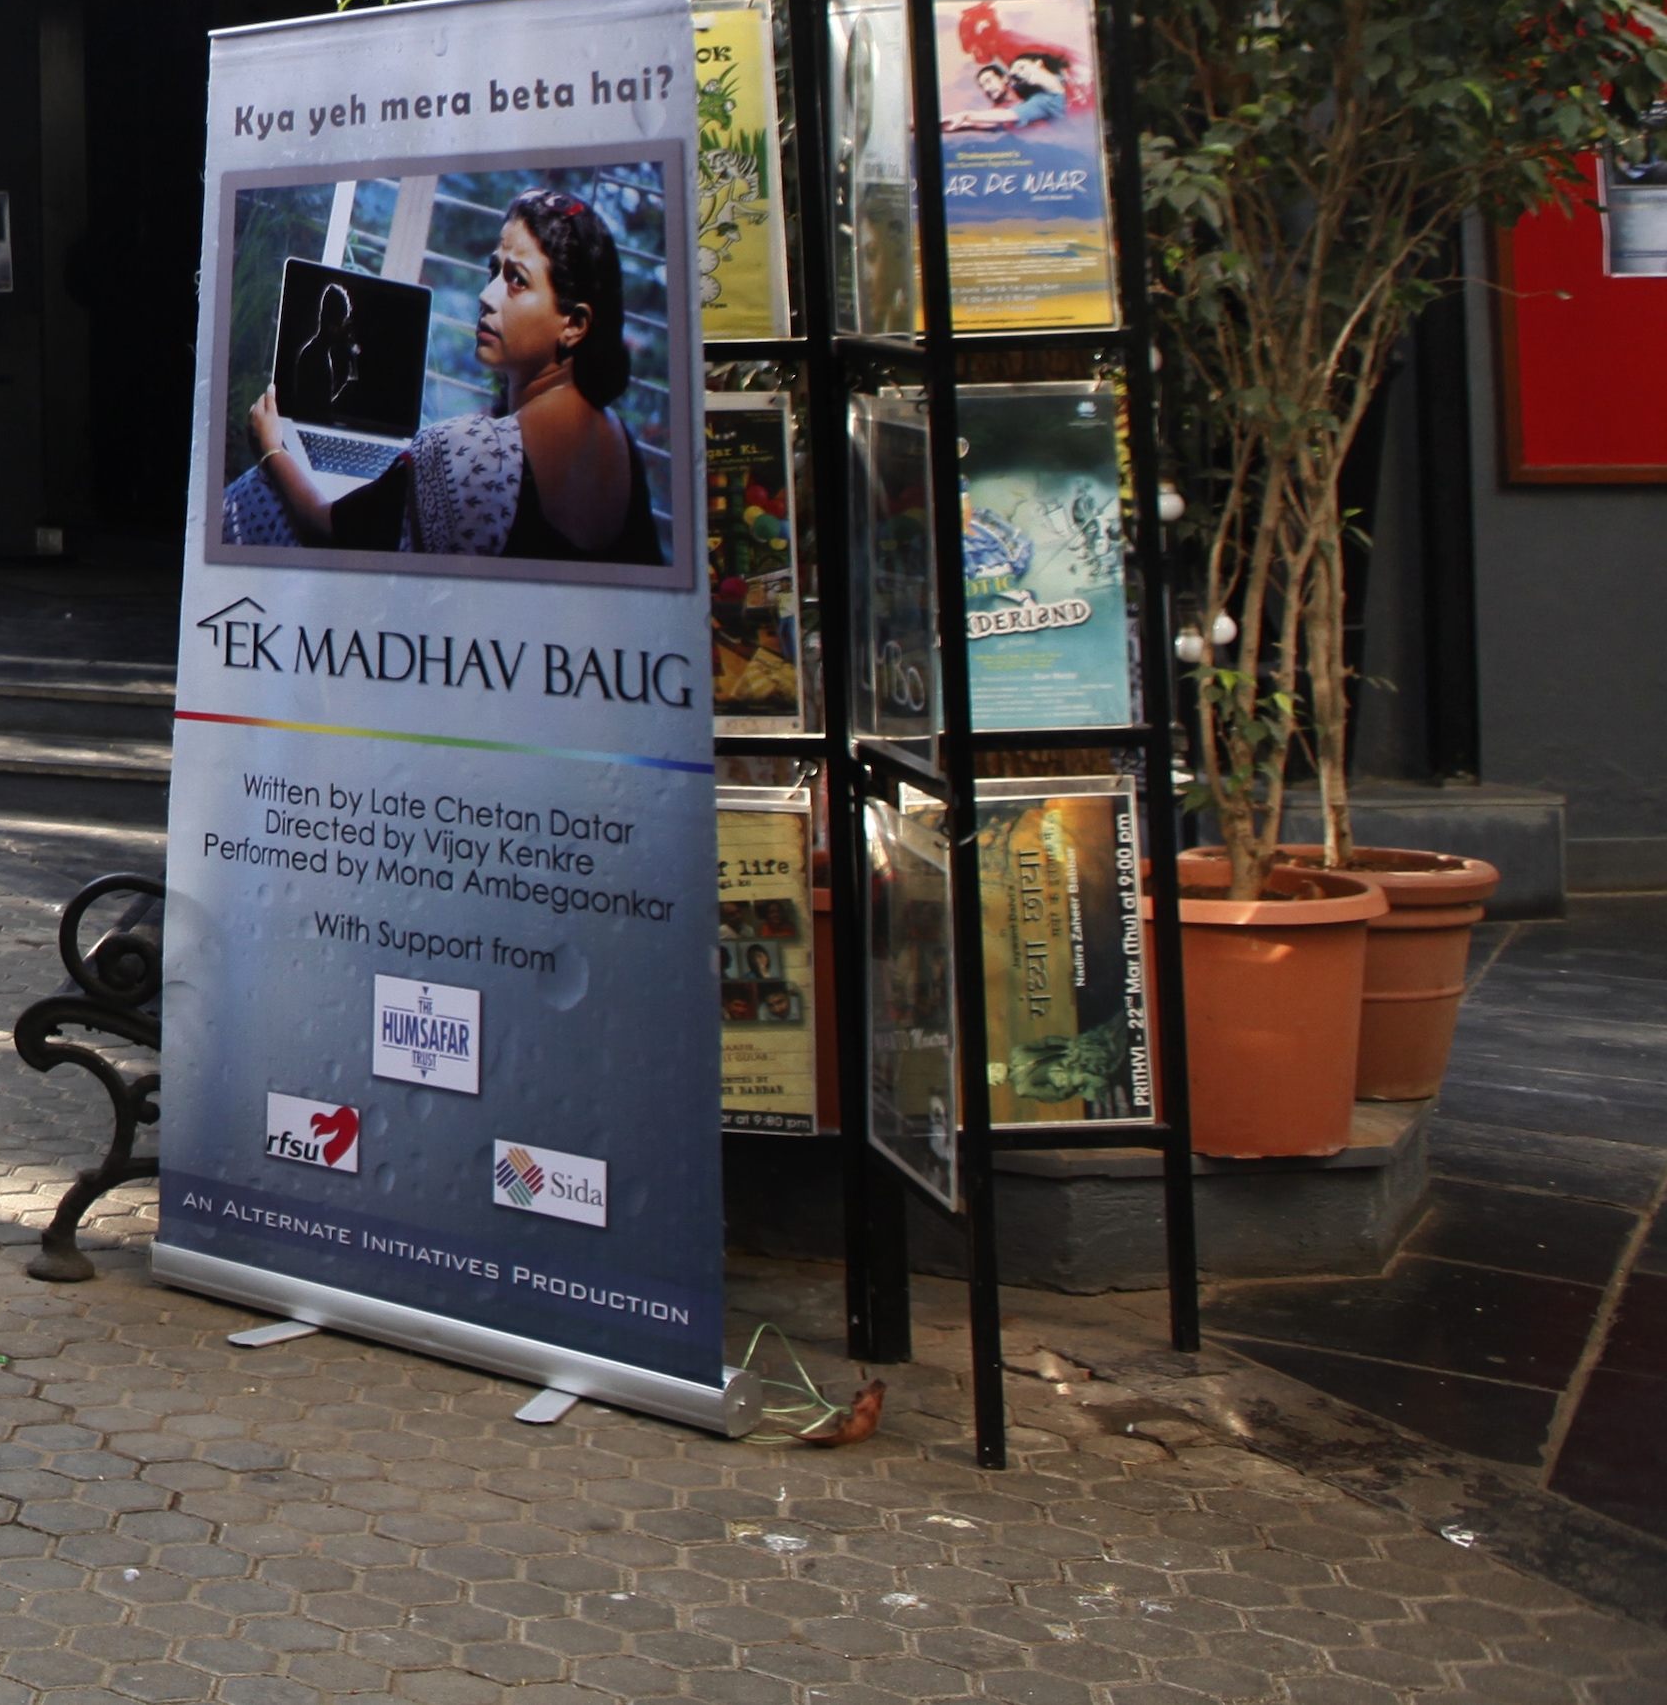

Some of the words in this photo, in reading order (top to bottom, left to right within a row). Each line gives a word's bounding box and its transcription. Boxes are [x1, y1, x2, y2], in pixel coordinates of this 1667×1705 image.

[235, 104, 295, 140] Kya
[309, 94, 366, 136] yeh
[381, 91, 471, 122] mera
[490, 78, 575, 114] beta
[592, 66, 673, 105] hai?
[983, 172, 1018, 195] DE
[1022, 169, 1089, 194] WAAR
[222, 621, 283, 673] EK
[294, 626, 528, 693] MADHAV
[545, 645, 693, 709] BAUG
[244, 773, 321, 809] Written
[329, 781, 362, 817] by
[371, 787, 426, 822] Late
[436, 795, 540, 834] Chetan
[551, 809, 634, 846] Datar
[1115, 813, 1134, 843] pm
[266, 809, 375, 847] Directed
[384, 818, 416, 858] by
[423, 821, 489, 865] Vijay
[499, 839, 594, 875] Kenkre
[204, 833, 327, 874] Performed
[336, 848, 369, 885] by
[377, 856, 454, 892] Mona
[463, 869, 675, 923] Ambegaonkar
[738, 859, 790, 876] life
[1065, 846, 1080, 893] Babbar
[1117, 848, 1134, 886] 9:00
[1069, 897, 1083, 941] Zaheer
[1119, 890, 1136, 909] at
[315, 911, 370, 945] With
[378, 920, 483, 961] Support
[493, 936, 556, 973] from
[1120, 913, 1142, 955] (Thu)
[1073, 945, 1086, 987] Nadira
[1123, 959, 1142, 993] Mar
[417, 999, 433, 1016] THE
[382, 1011, 470, 1057] HUMSAFAR
[411, 1049, 437, 1068] TRUST
[1133, 1045, 1151, 1107] PRITHVI
[786, 1119, 810, 1130] pm
[267, 1129, 320, 1163] rfsu
[550, 1171, 604, 1208] Sida
[183, 1192, 212, 1212] AN
[223, 1198, 351, 1246] ALTERNATE
[362, 1230, 500, 1281] INITIATIVES
[512, 1265, 690, 1327] PRODUCTION
